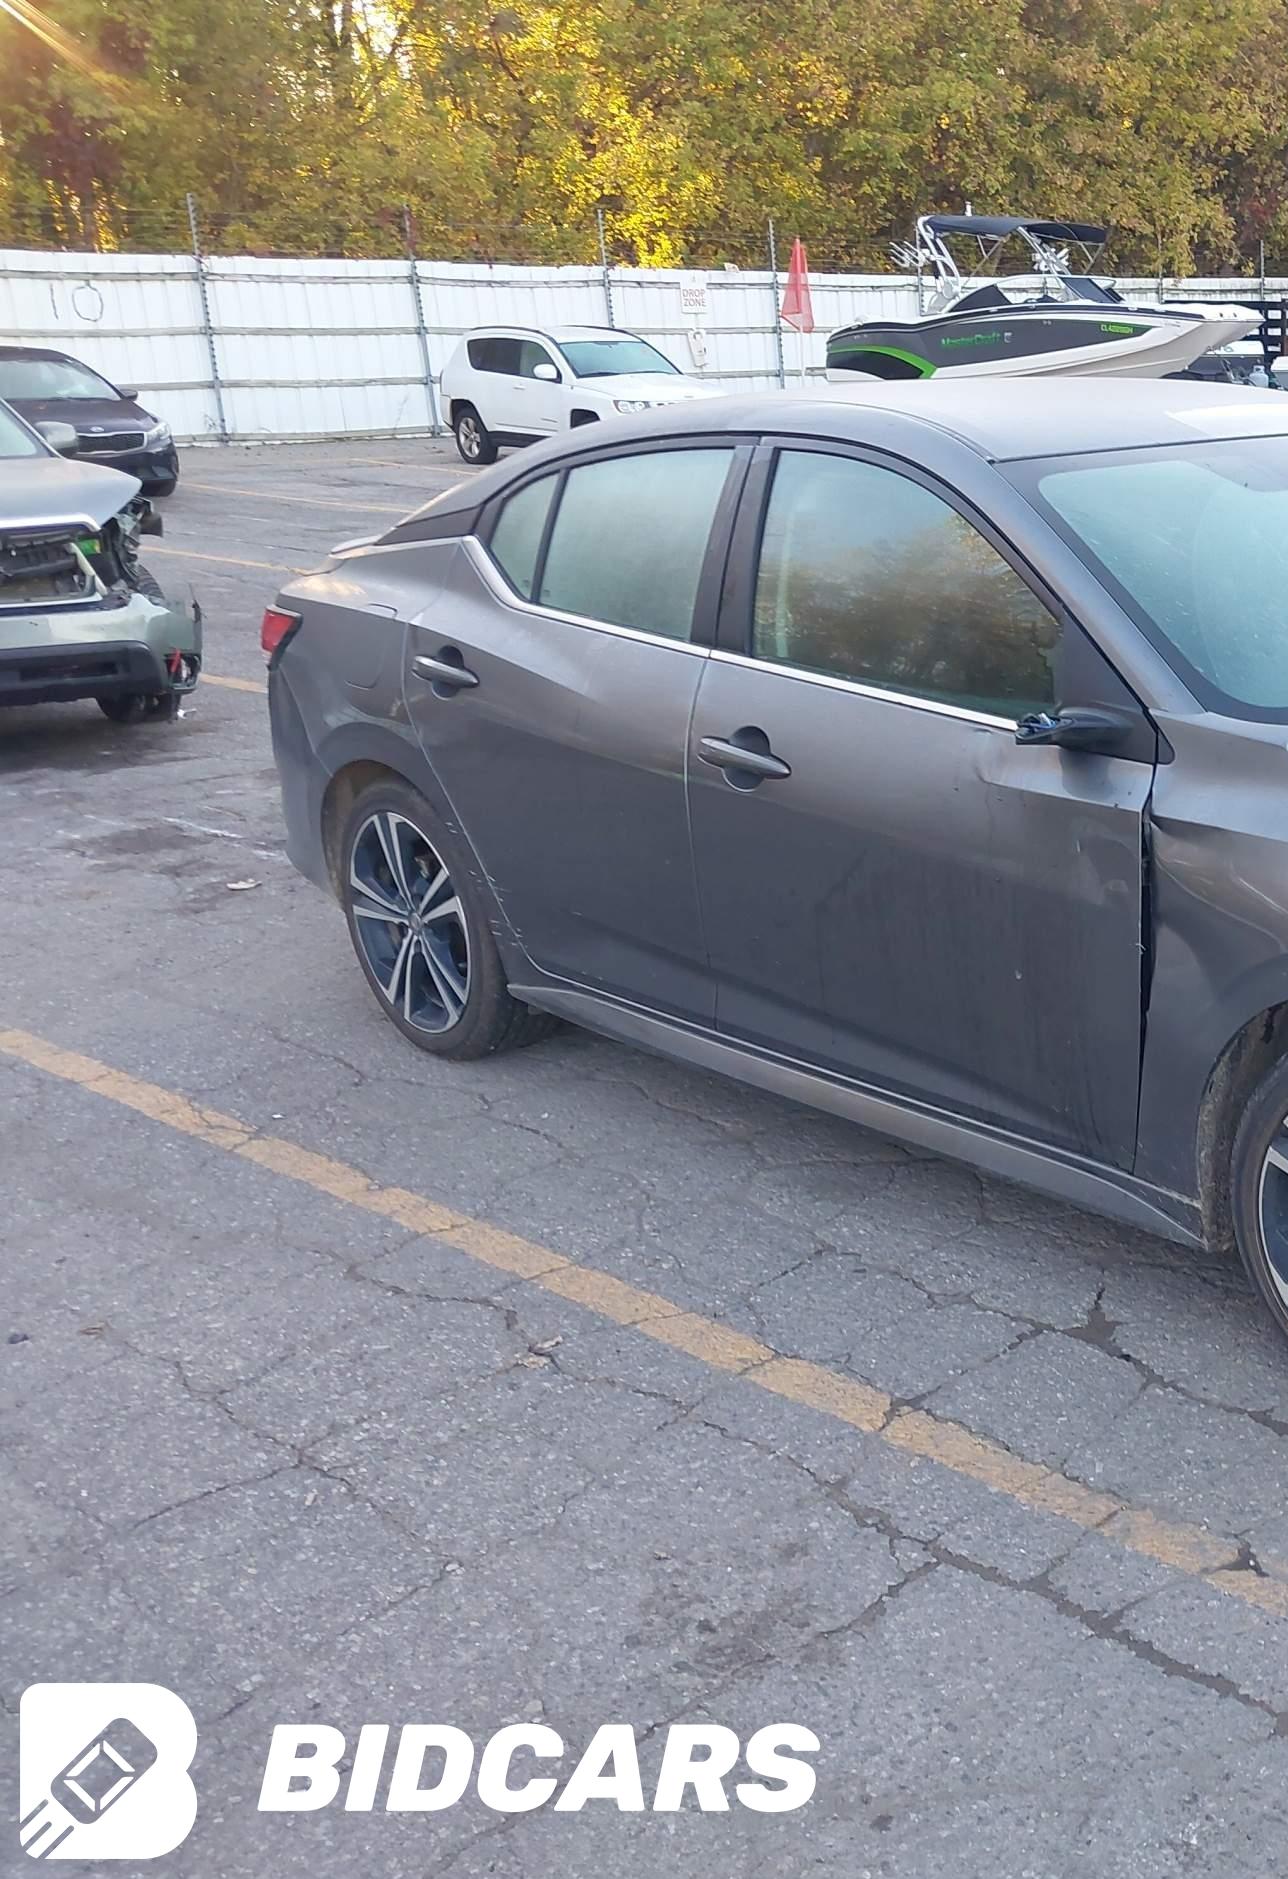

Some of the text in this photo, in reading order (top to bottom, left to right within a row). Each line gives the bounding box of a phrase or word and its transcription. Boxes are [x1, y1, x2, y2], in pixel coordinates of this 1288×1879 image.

[682, 289, 706, 297] DROP
[49, 282, 104, 322] 10
[683, 299, 706, 307] ZONE
